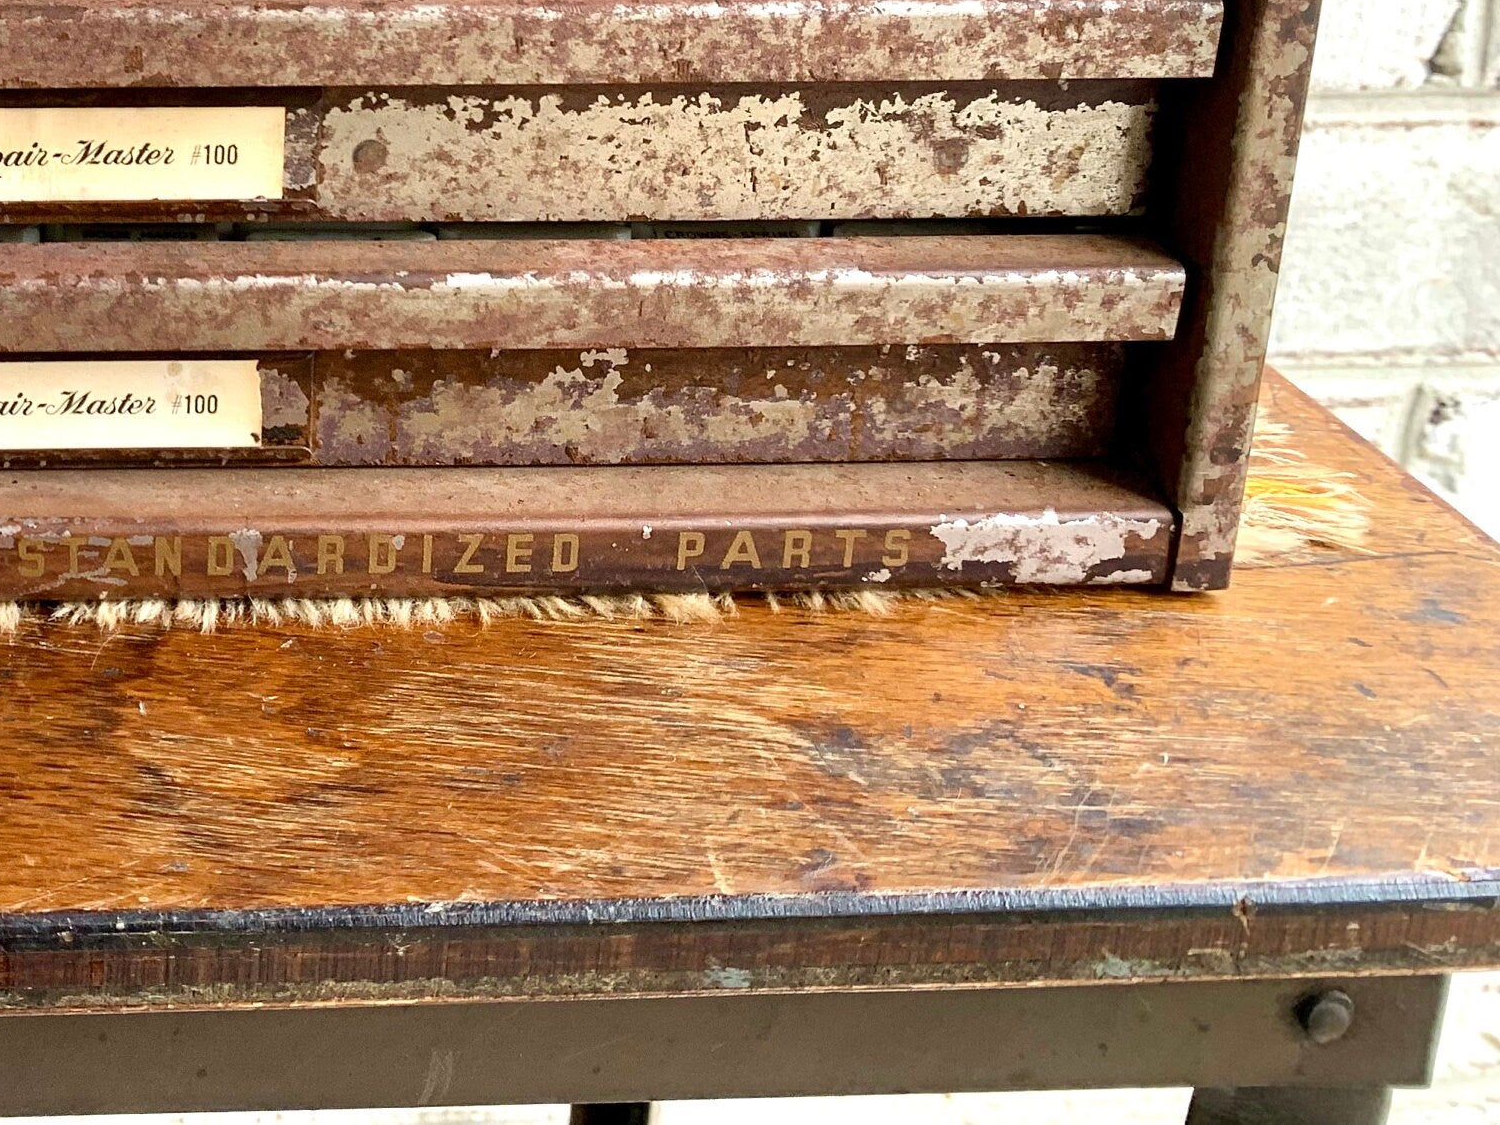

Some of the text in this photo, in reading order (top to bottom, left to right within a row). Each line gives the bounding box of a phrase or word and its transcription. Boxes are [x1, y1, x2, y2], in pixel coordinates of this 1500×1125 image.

[190, 143, 239, 165] #100
[171, 393, 219, 415] #100
[18, 531, 581, 577] STANDARDIZED
[674, 528, 911, 571] PARTS
